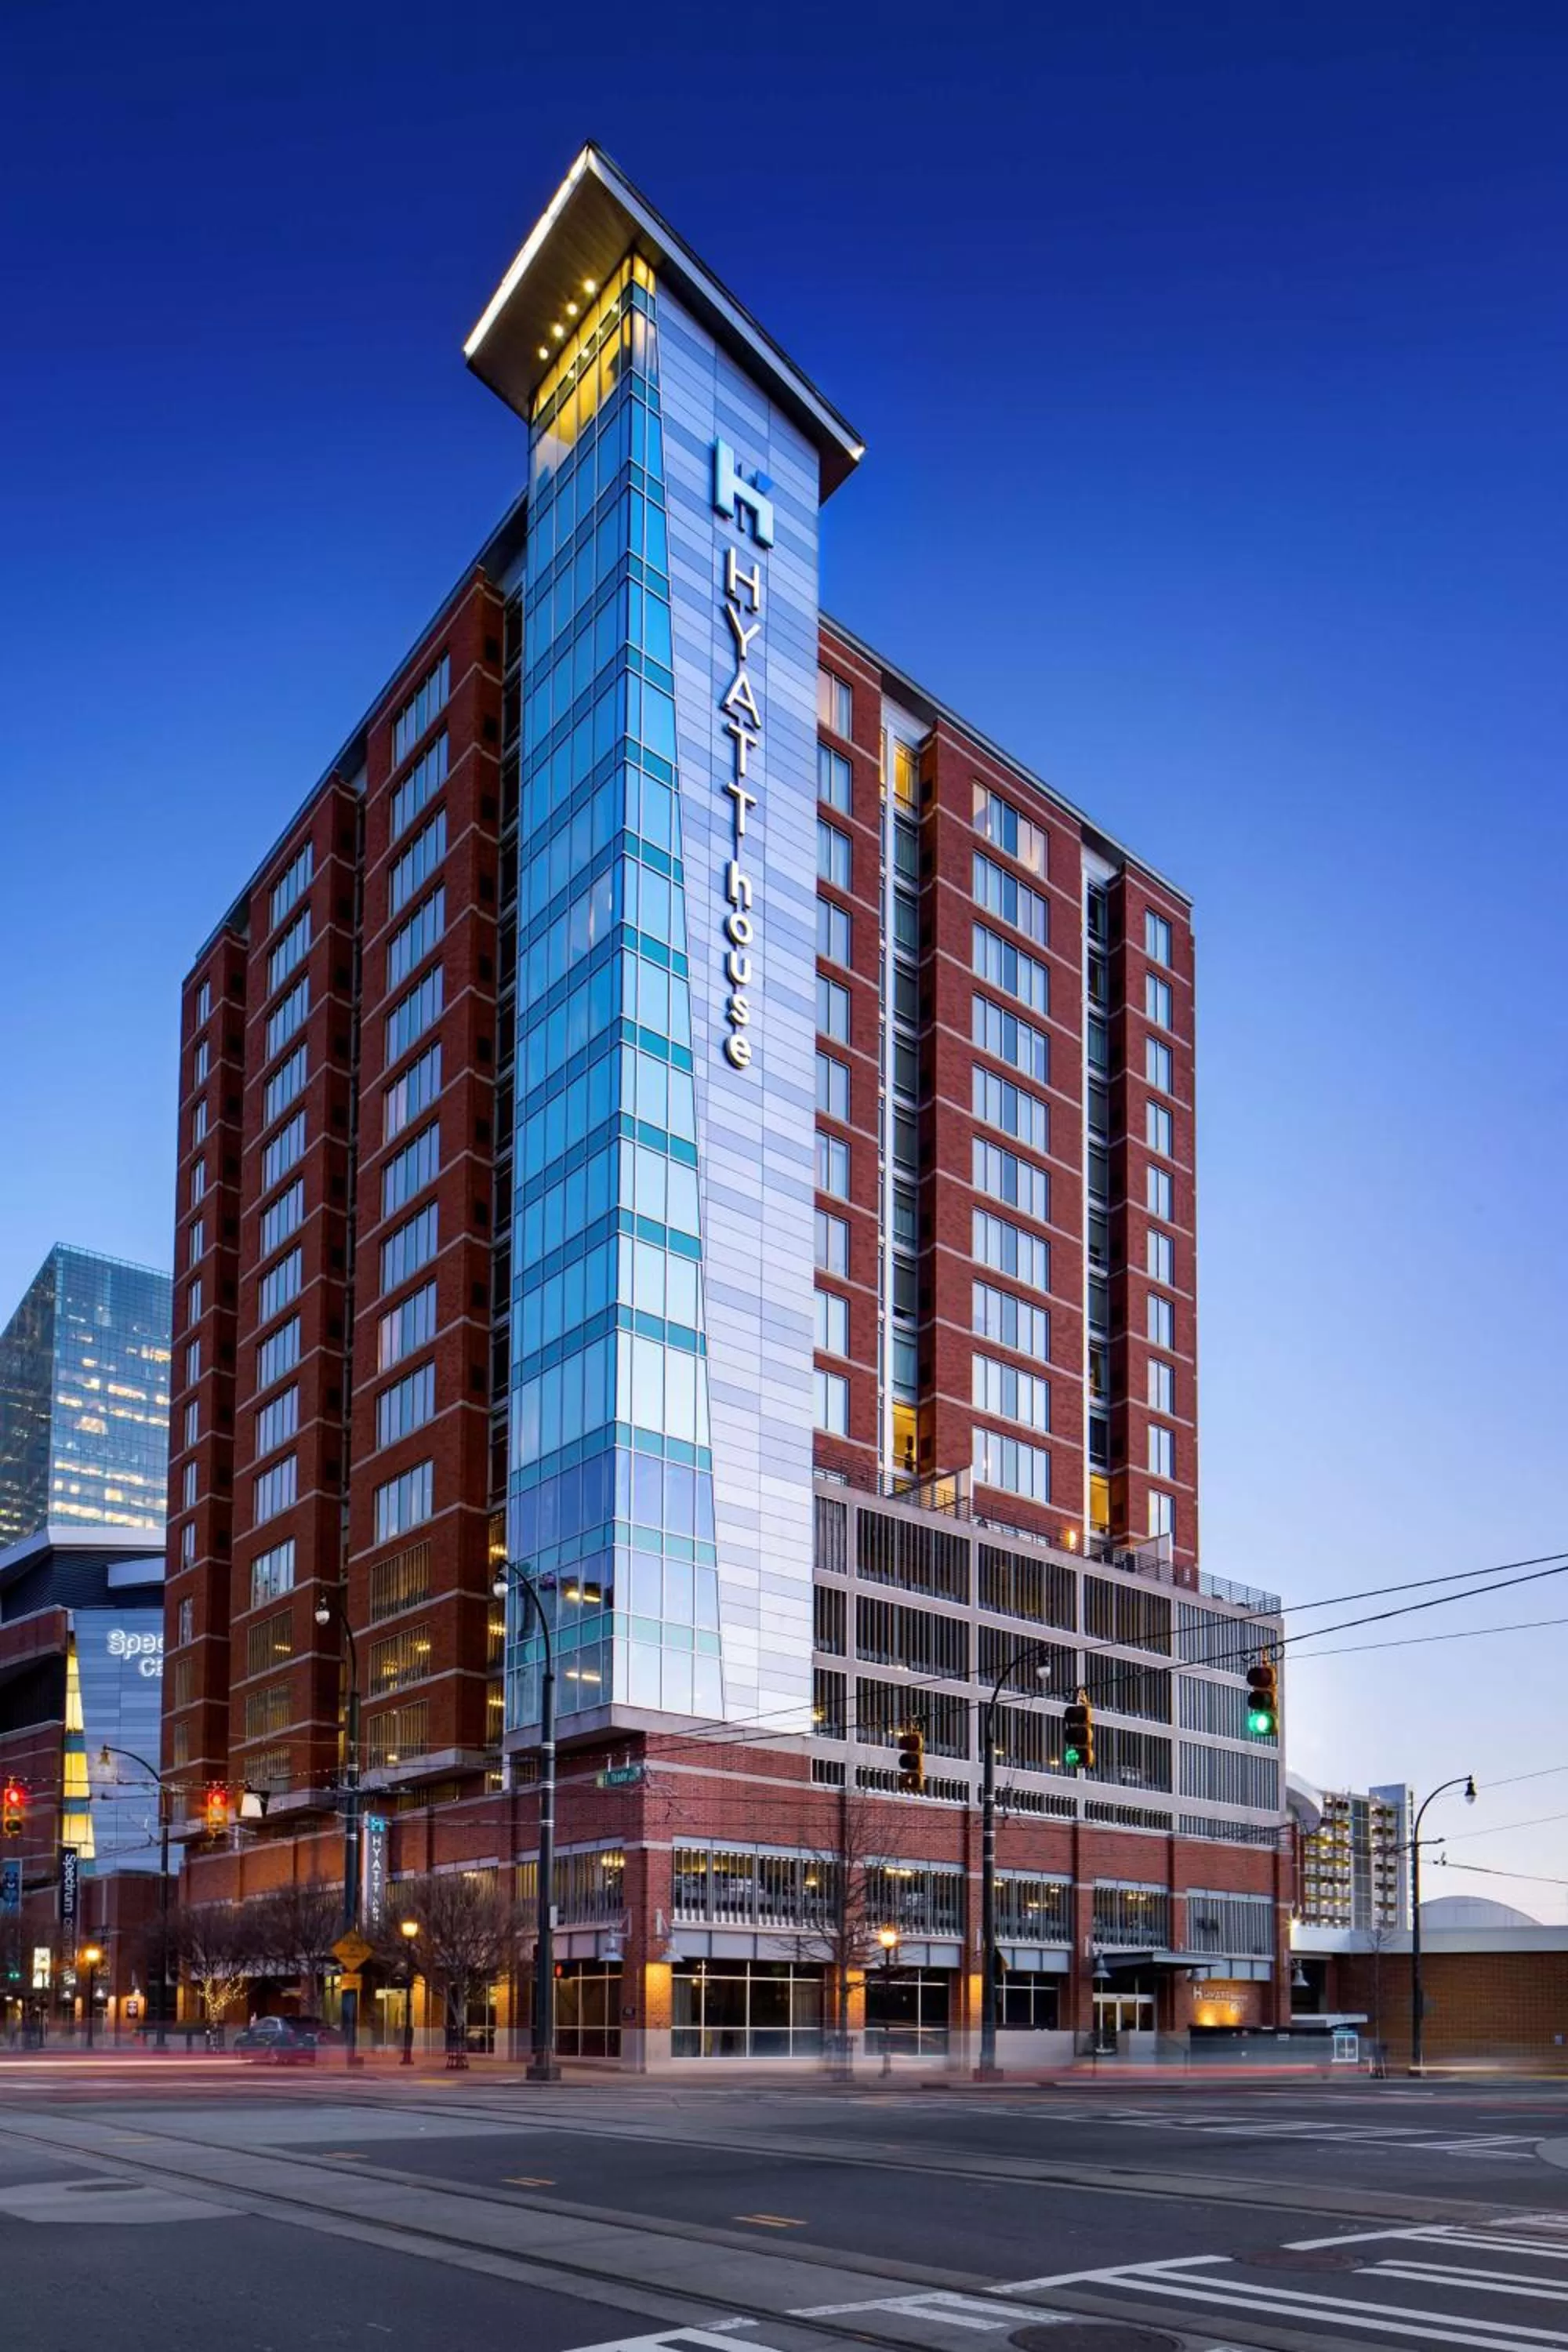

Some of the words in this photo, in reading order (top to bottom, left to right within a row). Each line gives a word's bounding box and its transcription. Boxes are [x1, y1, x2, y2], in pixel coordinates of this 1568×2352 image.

[722, 546, 762, 837] HYATT
[727, 860, 753, 1069] house
[372, 1835, 382, 1893] HYATT
